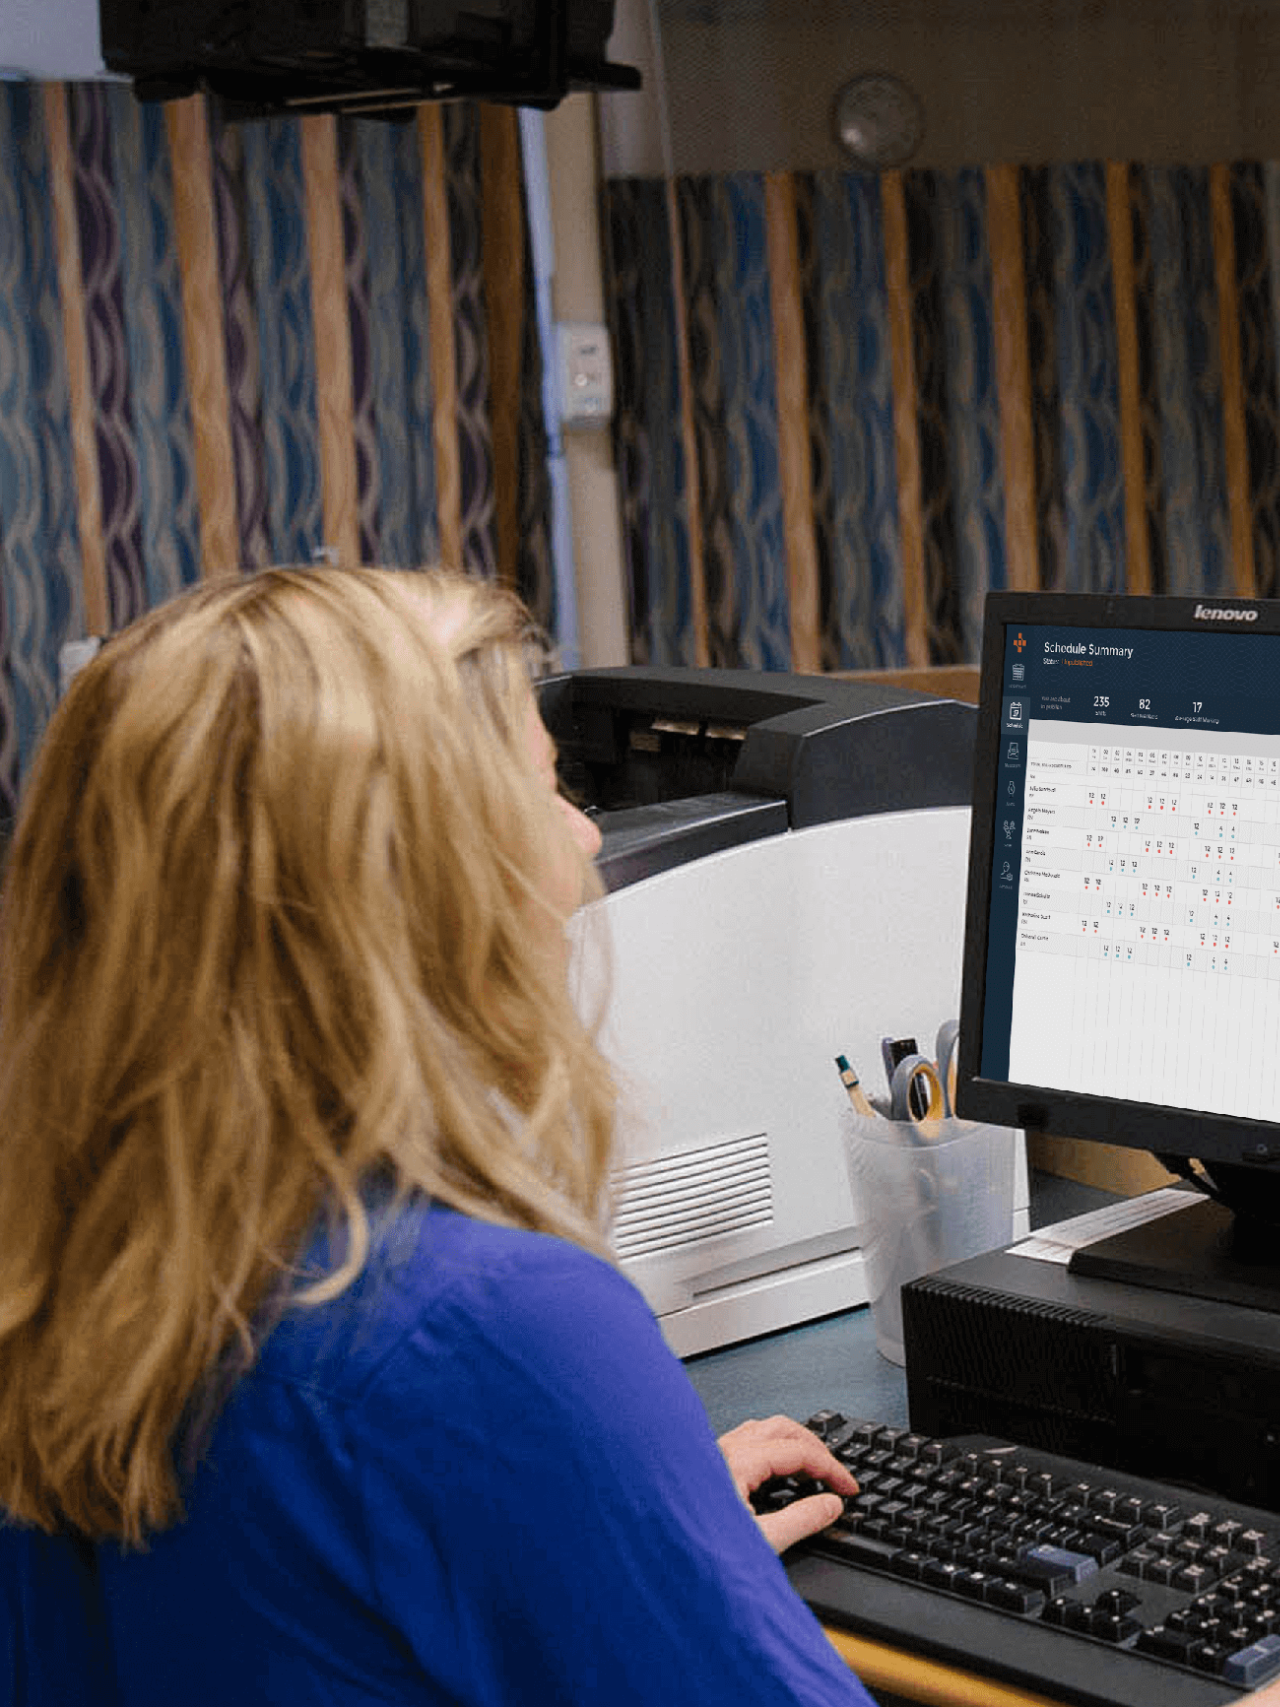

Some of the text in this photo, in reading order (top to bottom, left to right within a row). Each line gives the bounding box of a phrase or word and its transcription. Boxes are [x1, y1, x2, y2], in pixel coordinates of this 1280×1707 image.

[1194, 604, 1259, 622] lenovo
[1044, 641, 1134, 659] Schedule Summary
[1093, 695, 1110, 707] 235
[1138, 698, 1151, 711] 82
[1192, 701, 1203, 713] 17
